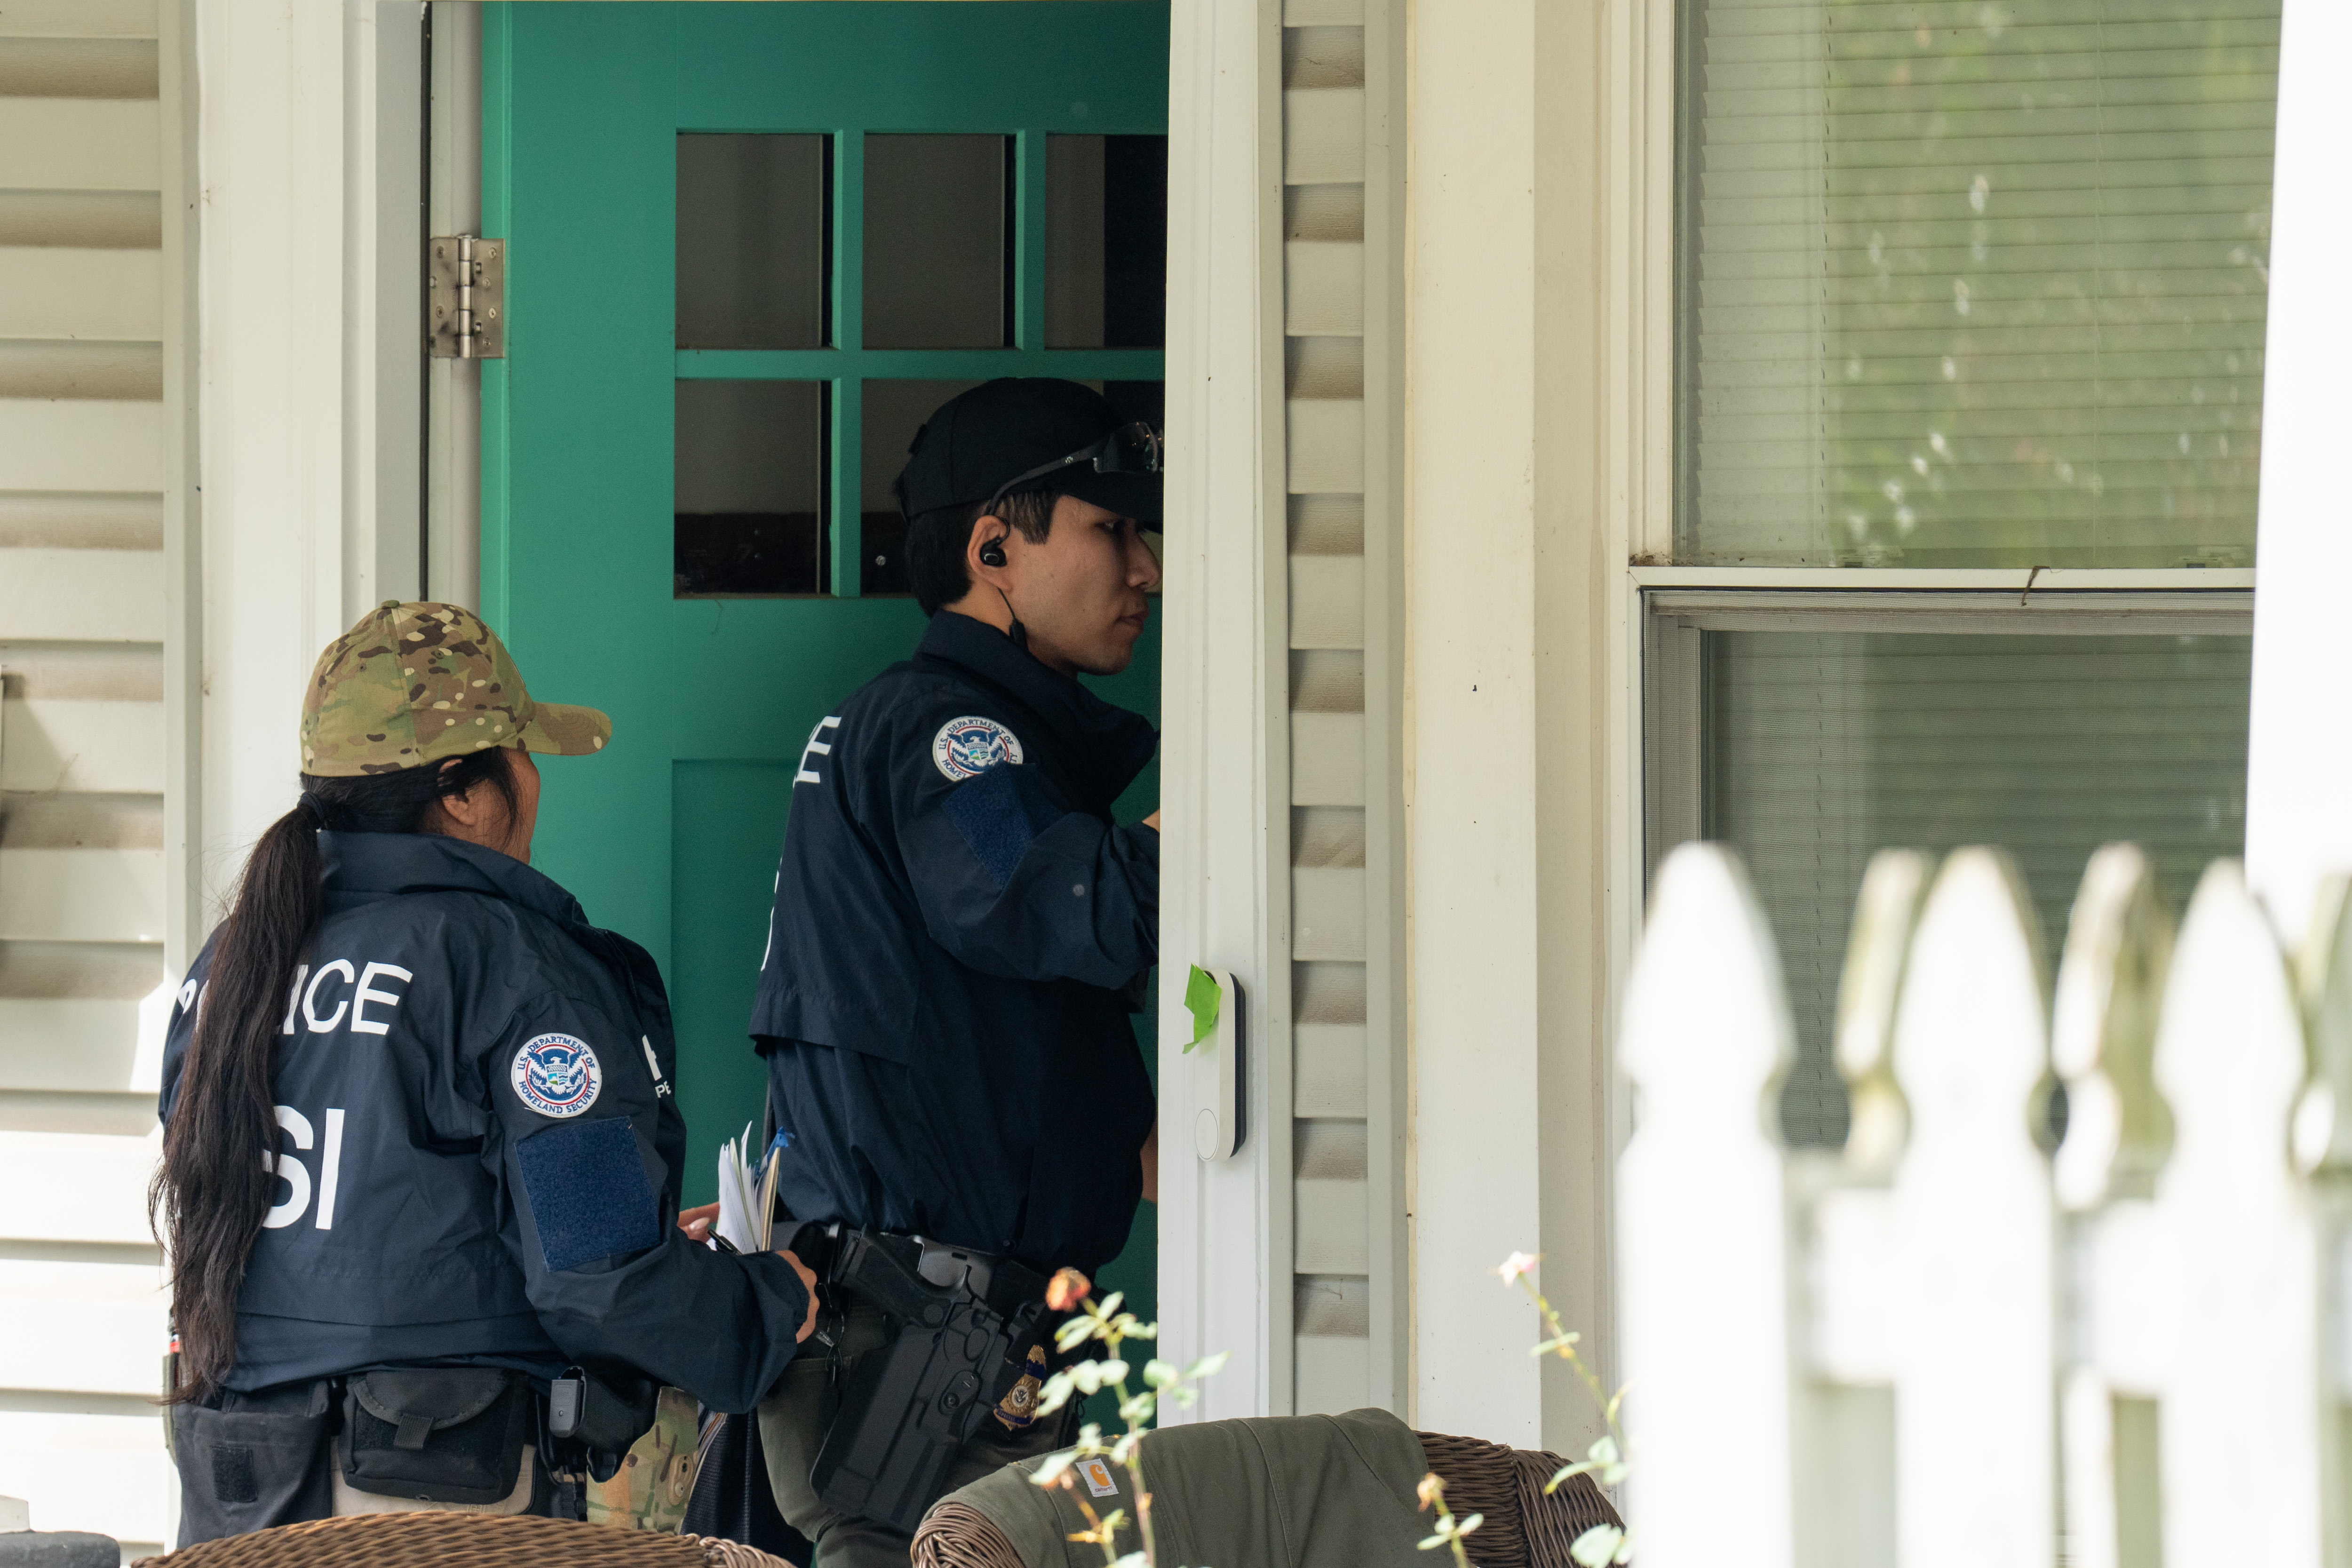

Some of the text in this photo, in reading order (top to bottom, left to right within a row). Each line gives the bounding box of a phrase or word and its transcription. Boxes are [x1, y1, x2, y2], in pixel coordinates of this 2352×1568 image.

[947, 719, 1005, 735] DEPARTMENT
[1004, 735, 1014, 745] OF
[177, 958, 413, 1035] PICE
[517, 1036, 596, 1070] U.S. DEPARTMENT OF
[518, 1078, 597, 1114] HOMELAND SECURITY
[262, 1105, 345, 1230] SI
